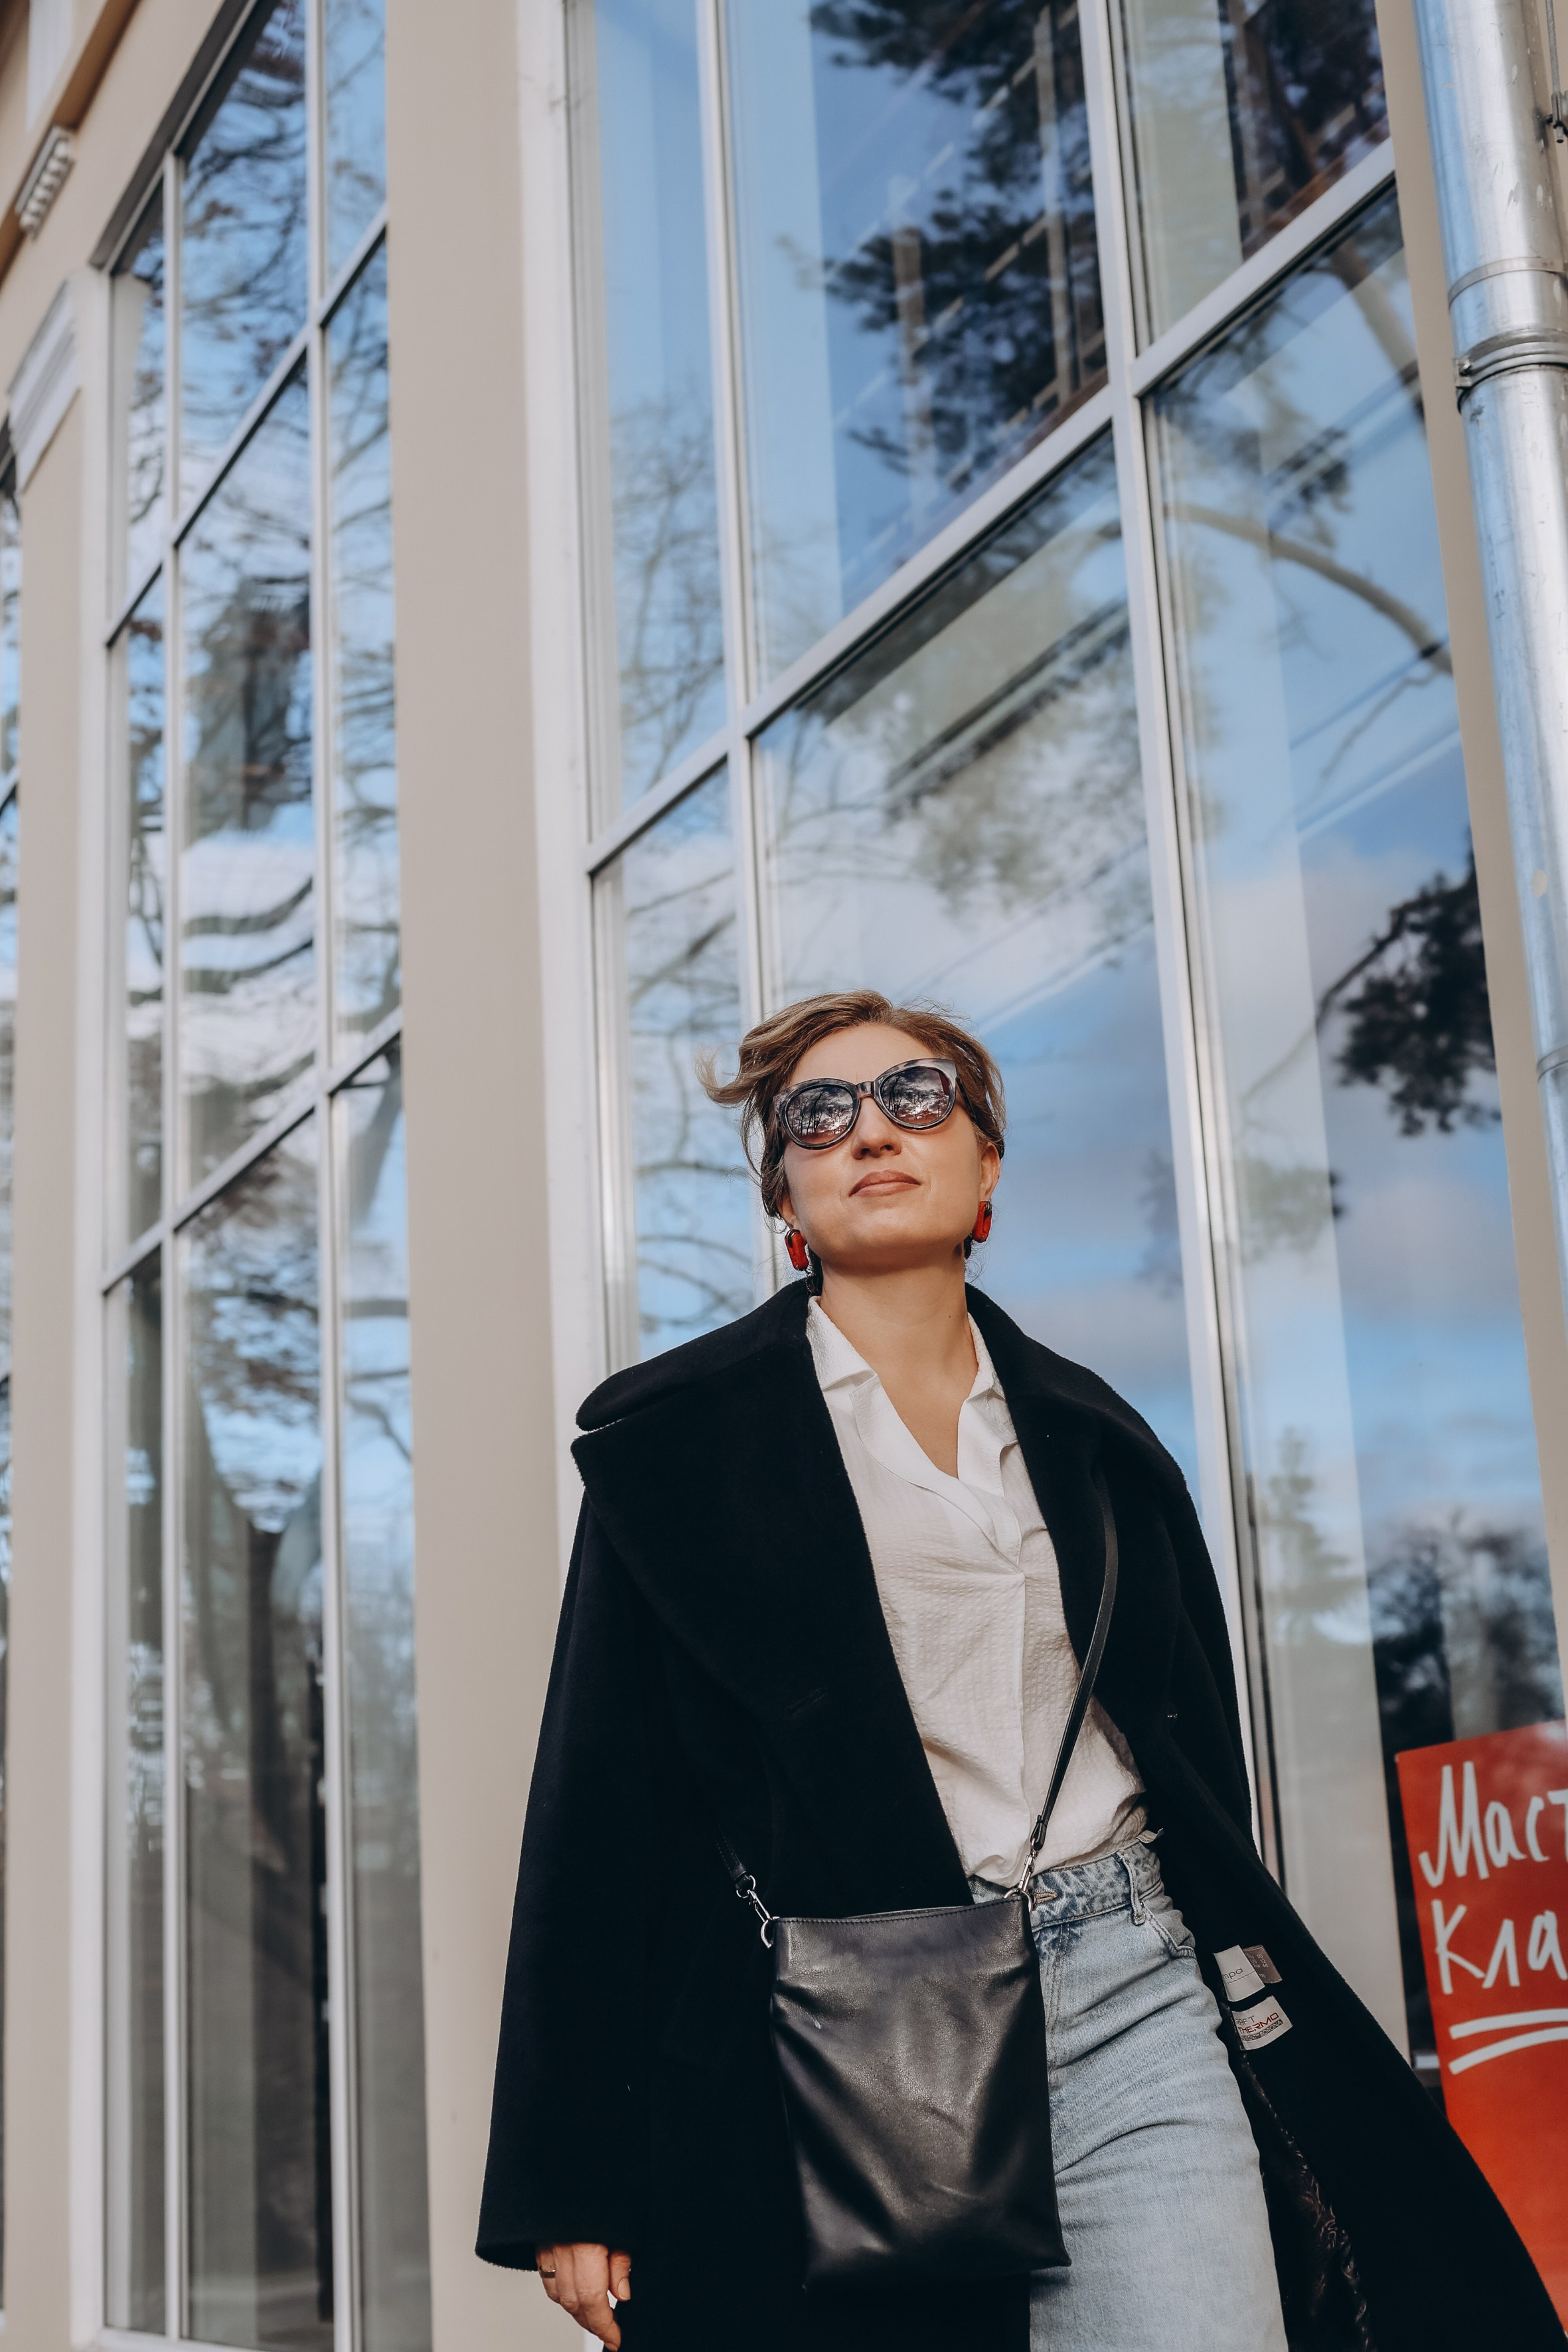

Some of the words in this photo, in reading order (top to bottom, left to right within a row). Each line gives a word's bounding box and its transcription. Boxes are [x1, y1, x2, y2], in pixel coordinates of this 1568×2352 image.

[1431, 1899, 1568, 1995] Кла
[1237, 2012, 1279, 2034] THERMO
[1259, 2019, 1283, 2037] SORONA
